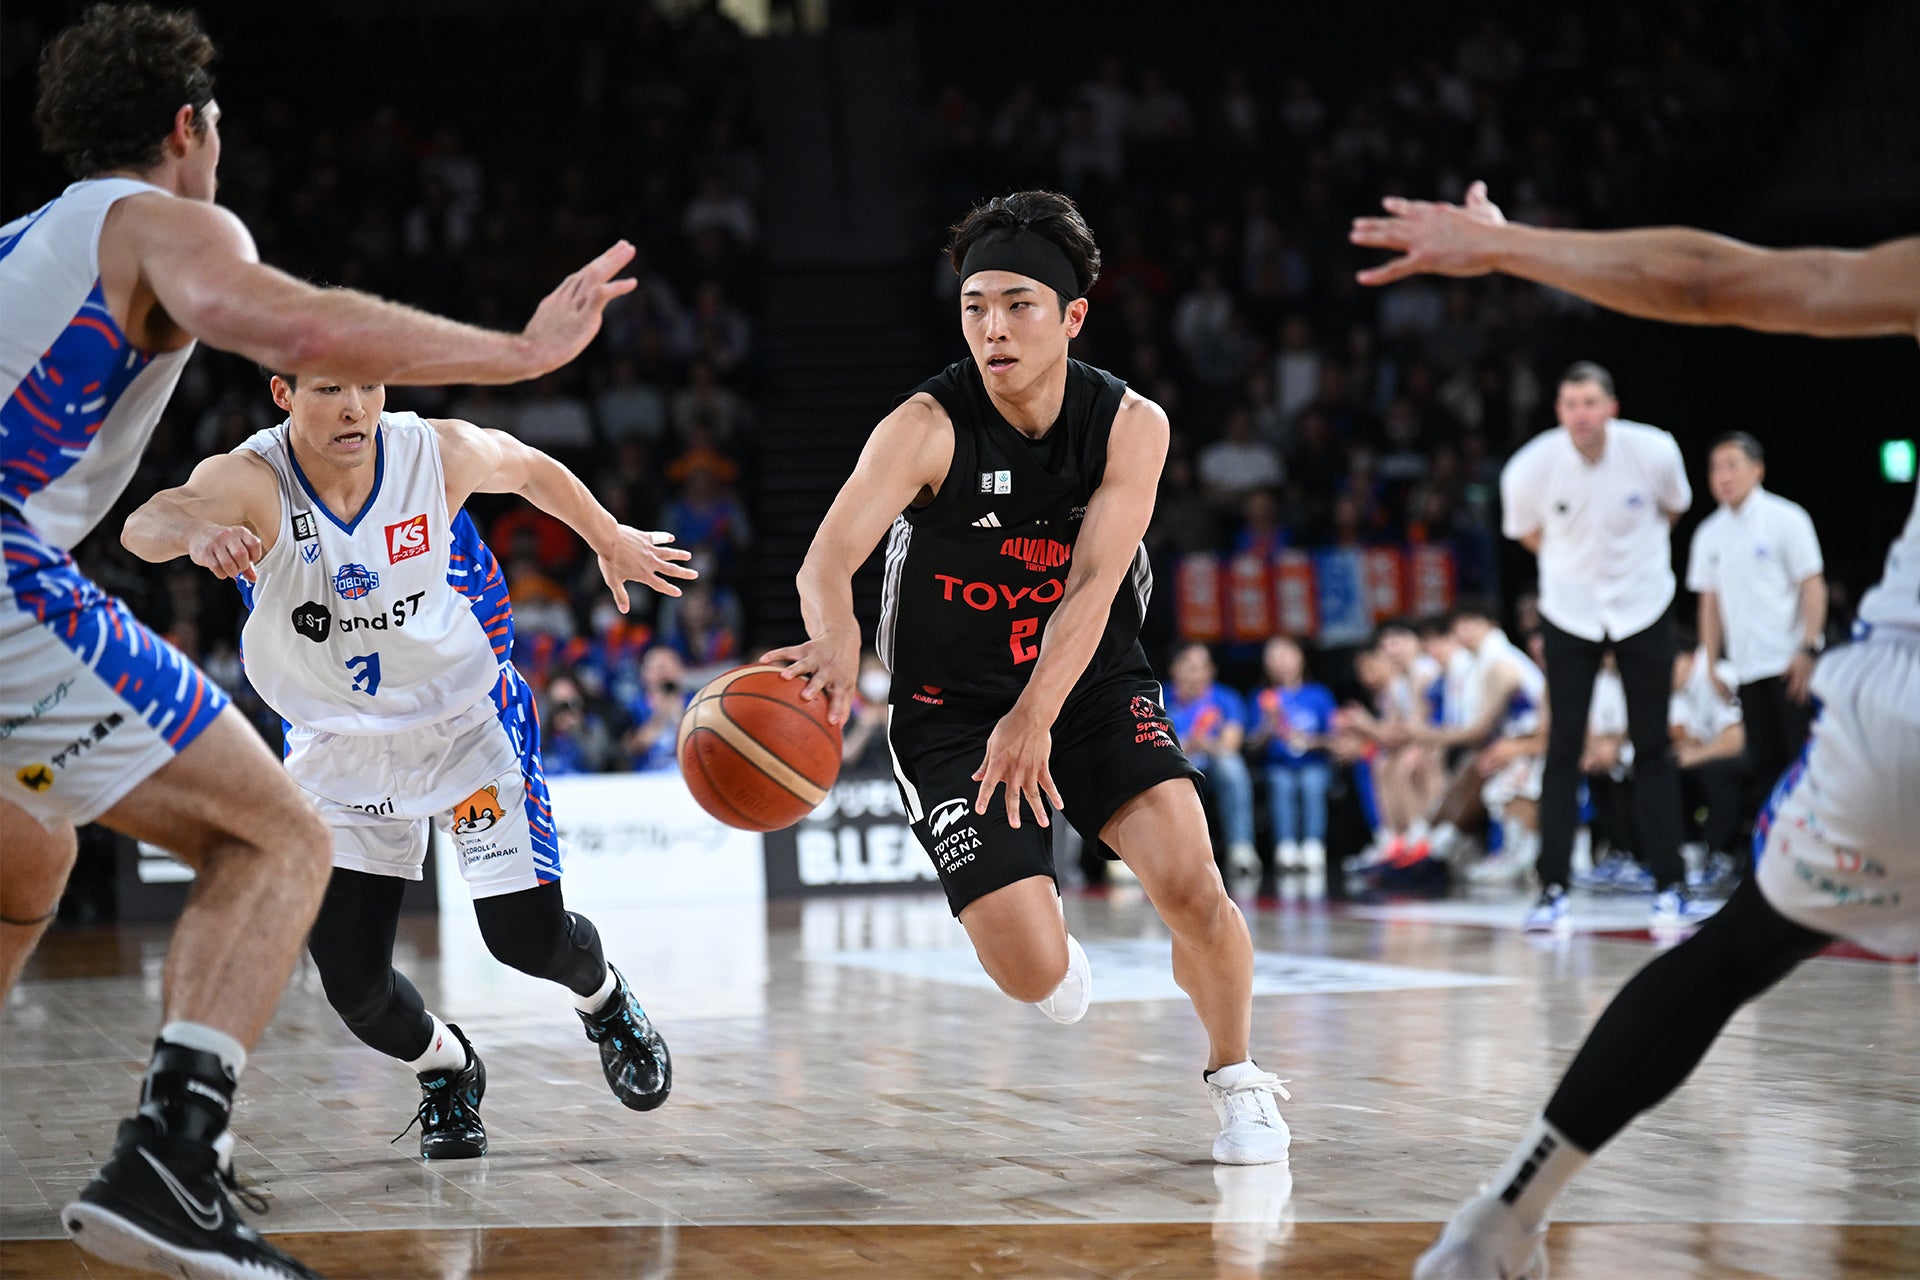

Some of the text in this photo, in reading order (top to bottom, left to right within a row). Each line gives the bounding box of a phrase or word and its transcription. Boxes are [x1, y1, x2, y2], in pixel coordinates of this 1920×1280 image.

[1025, 561, 1047, 573] TOKYO
[935, 574, 1067, 611] TOYO
[339, 591, 426, 632] and ST
[1010, 617, 1039, 665] 2
[465, 843, 497, 855] COROLLA
[934, 826, 978, 856] TOYOTA
[939, 837, 982, 868] ARENA
[947, 853, 976, 874] TOKYO
